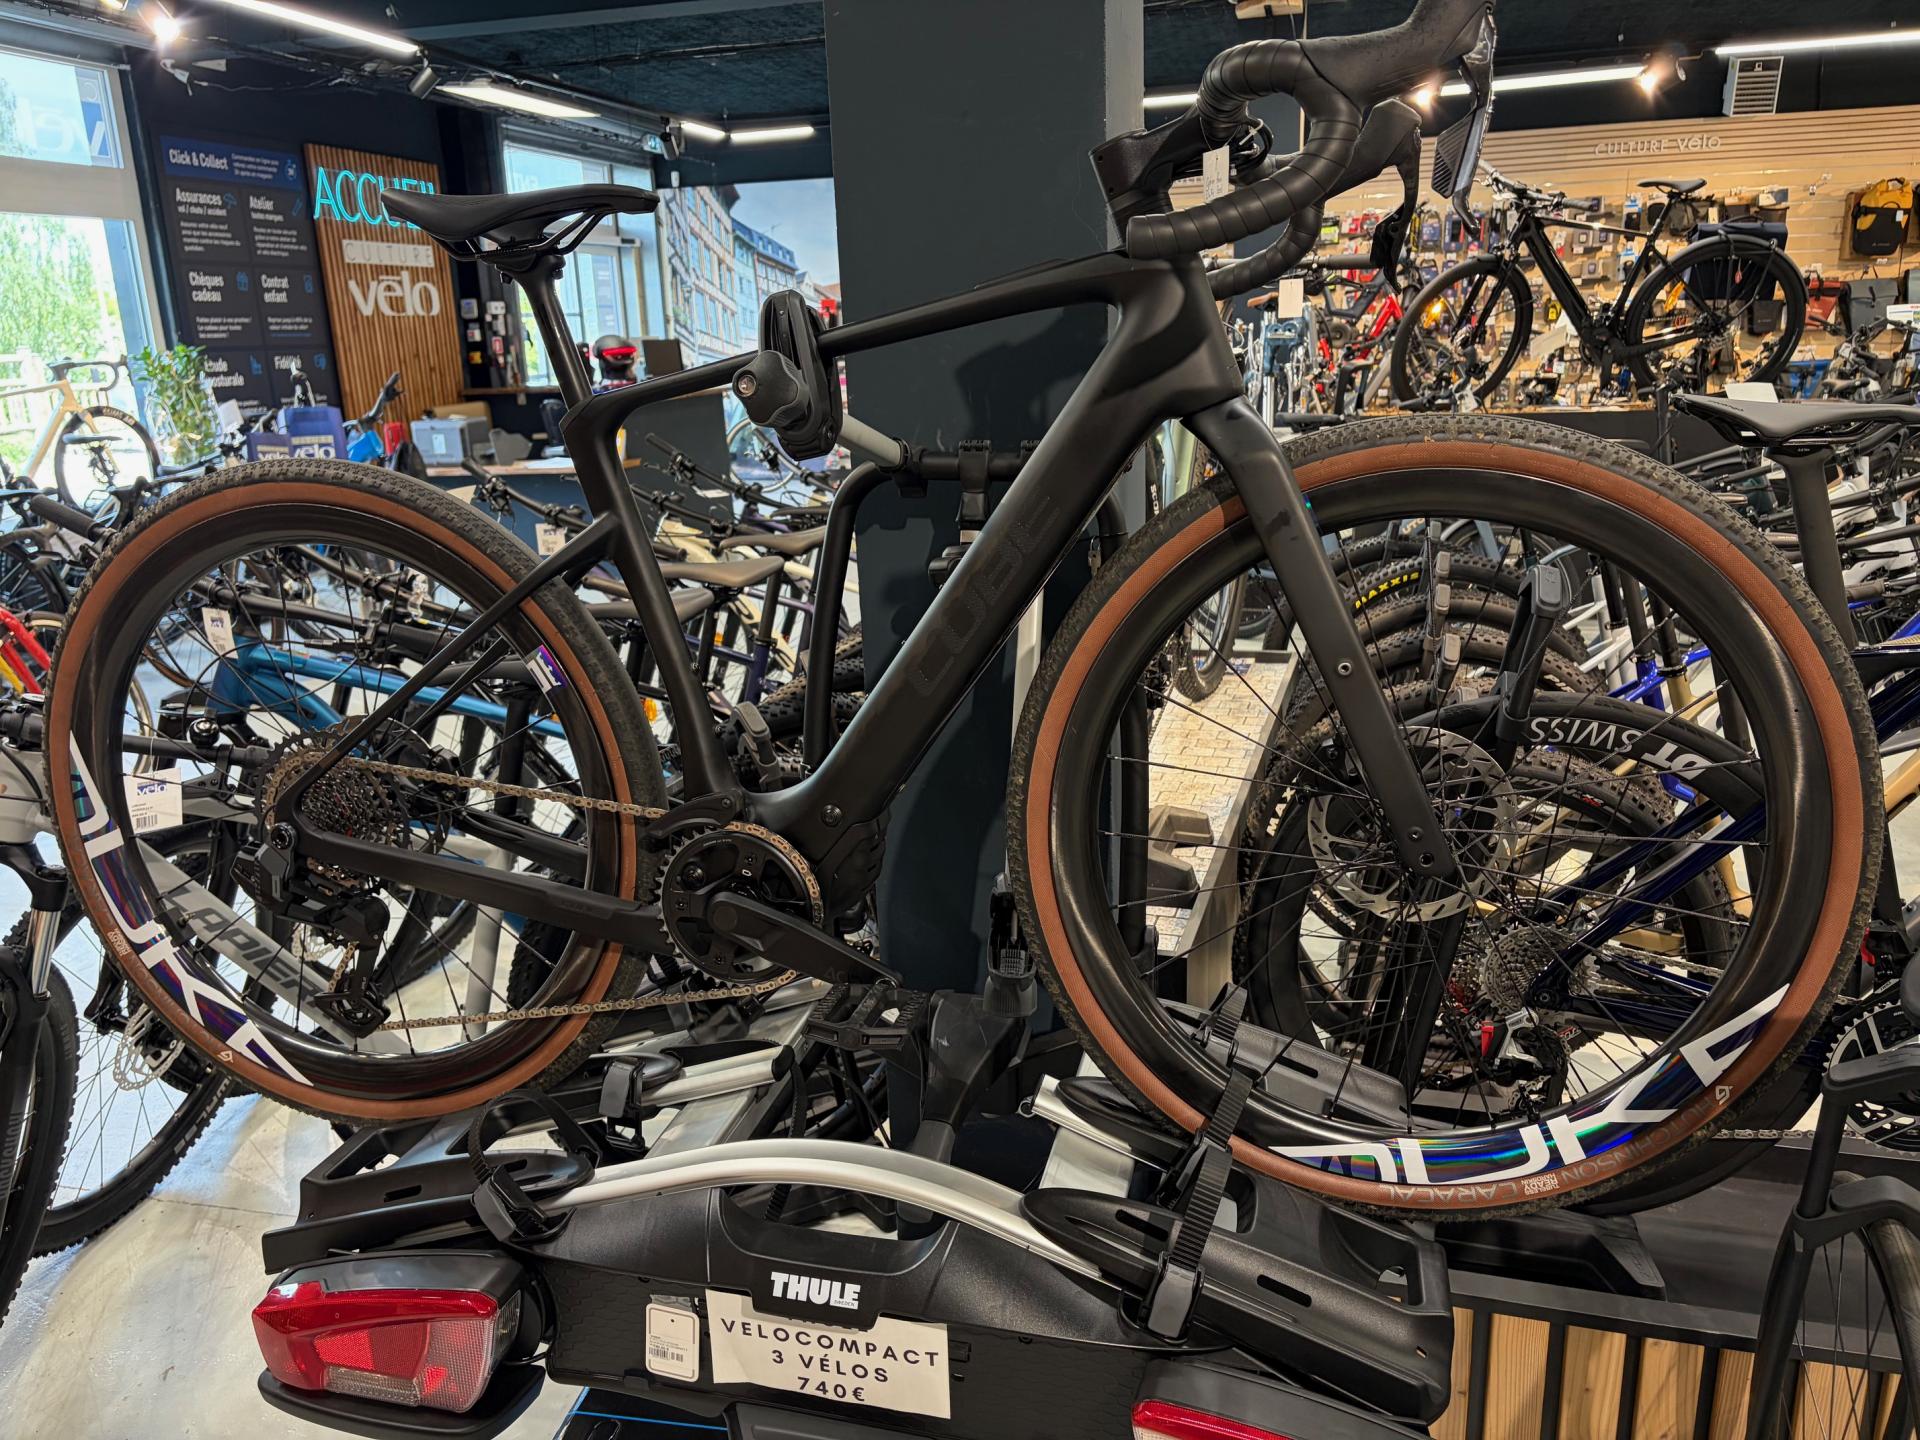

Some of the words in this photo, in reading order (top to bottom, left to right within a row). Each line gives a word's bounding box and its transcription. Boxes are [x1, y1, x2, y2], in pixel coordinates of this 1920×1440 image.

[168, 148, 191, 166] Click
[199, 153, 229, 171] Collect
[175, 187, 223, 206] Assurances
[249, 195, 274, 211] Atelier
[343, 242, 434, 266] CULTURE
[261, 273, 290, 289] Contrat
[191, 287, 222, 302] cadeau
[263, 288, 289, 303] enfant
[1529, 716, 1644, 754] SWISS
[1641, 741, 1713, 781] DT
[1377, 1182, 1518, 1202] CARACAL
[770, 1271, 861, 1306] THULE
[720, 1317, 939, 1367] VELOCOMPACT
[772, 1349, 784, 1364] 3
[798, 1353, 889, 1383] VÉLOS
[797, 1376, 866, 1402] 740€
